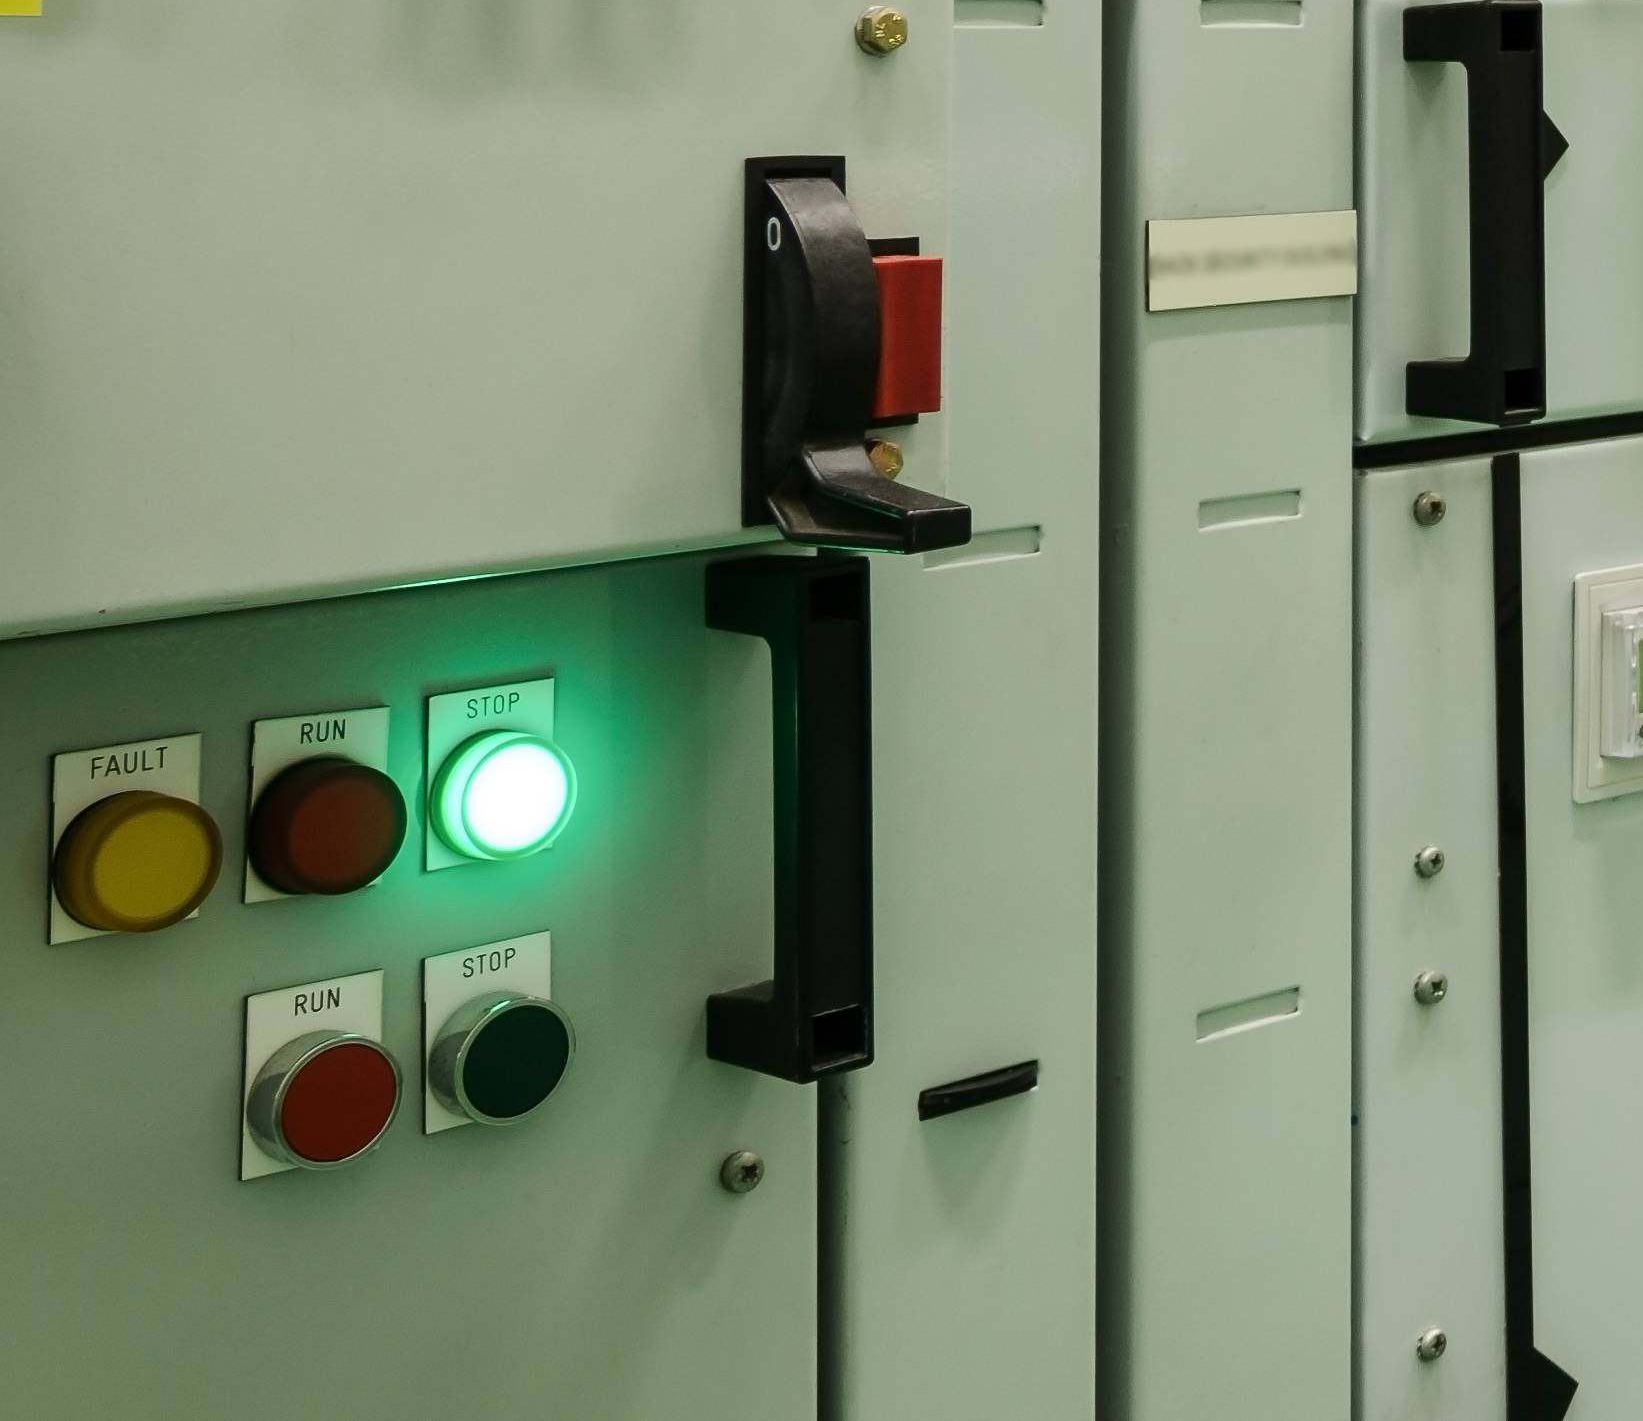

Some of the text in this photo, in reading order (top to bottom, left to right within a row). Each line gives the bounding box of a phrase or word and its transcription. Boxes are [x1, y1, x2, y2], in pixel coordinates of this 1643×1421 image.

[466, 691, 520, 719] STOP
[299, 718, 347, 745] RUN
[90, 746, 168, 779] FAULT
[462, 947, 516, 978] STOP
[294, 986, 341, 1016] RUN
